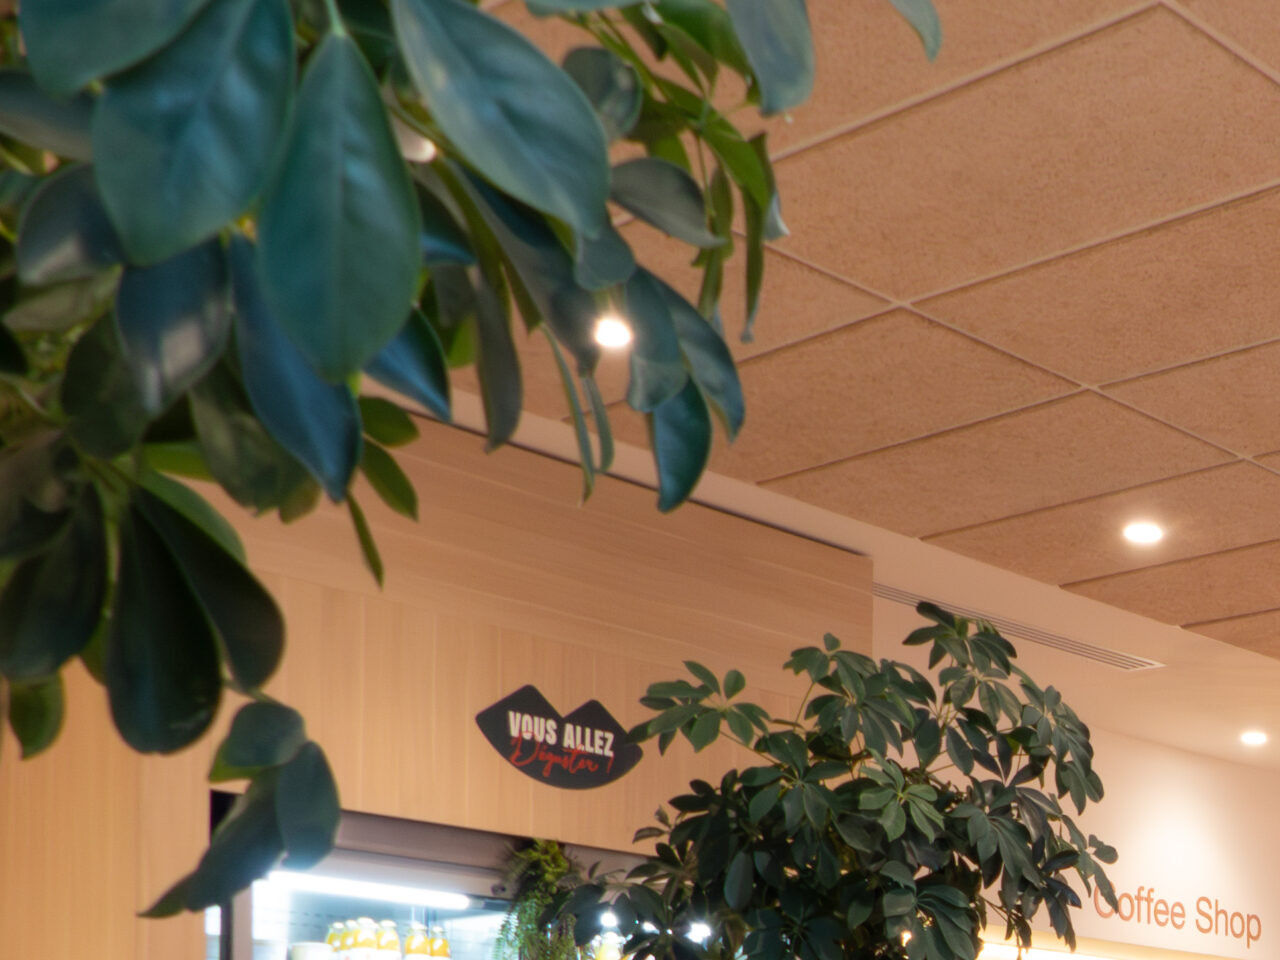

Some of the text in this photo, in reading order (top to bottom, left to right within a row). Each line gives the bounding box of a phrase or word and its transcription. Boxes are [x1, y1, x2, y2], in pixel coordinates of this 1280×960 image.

[508, 710, 615, 757] VOUS ALLEZ
[1094, 880, 1262, 948] Coffee Shop
